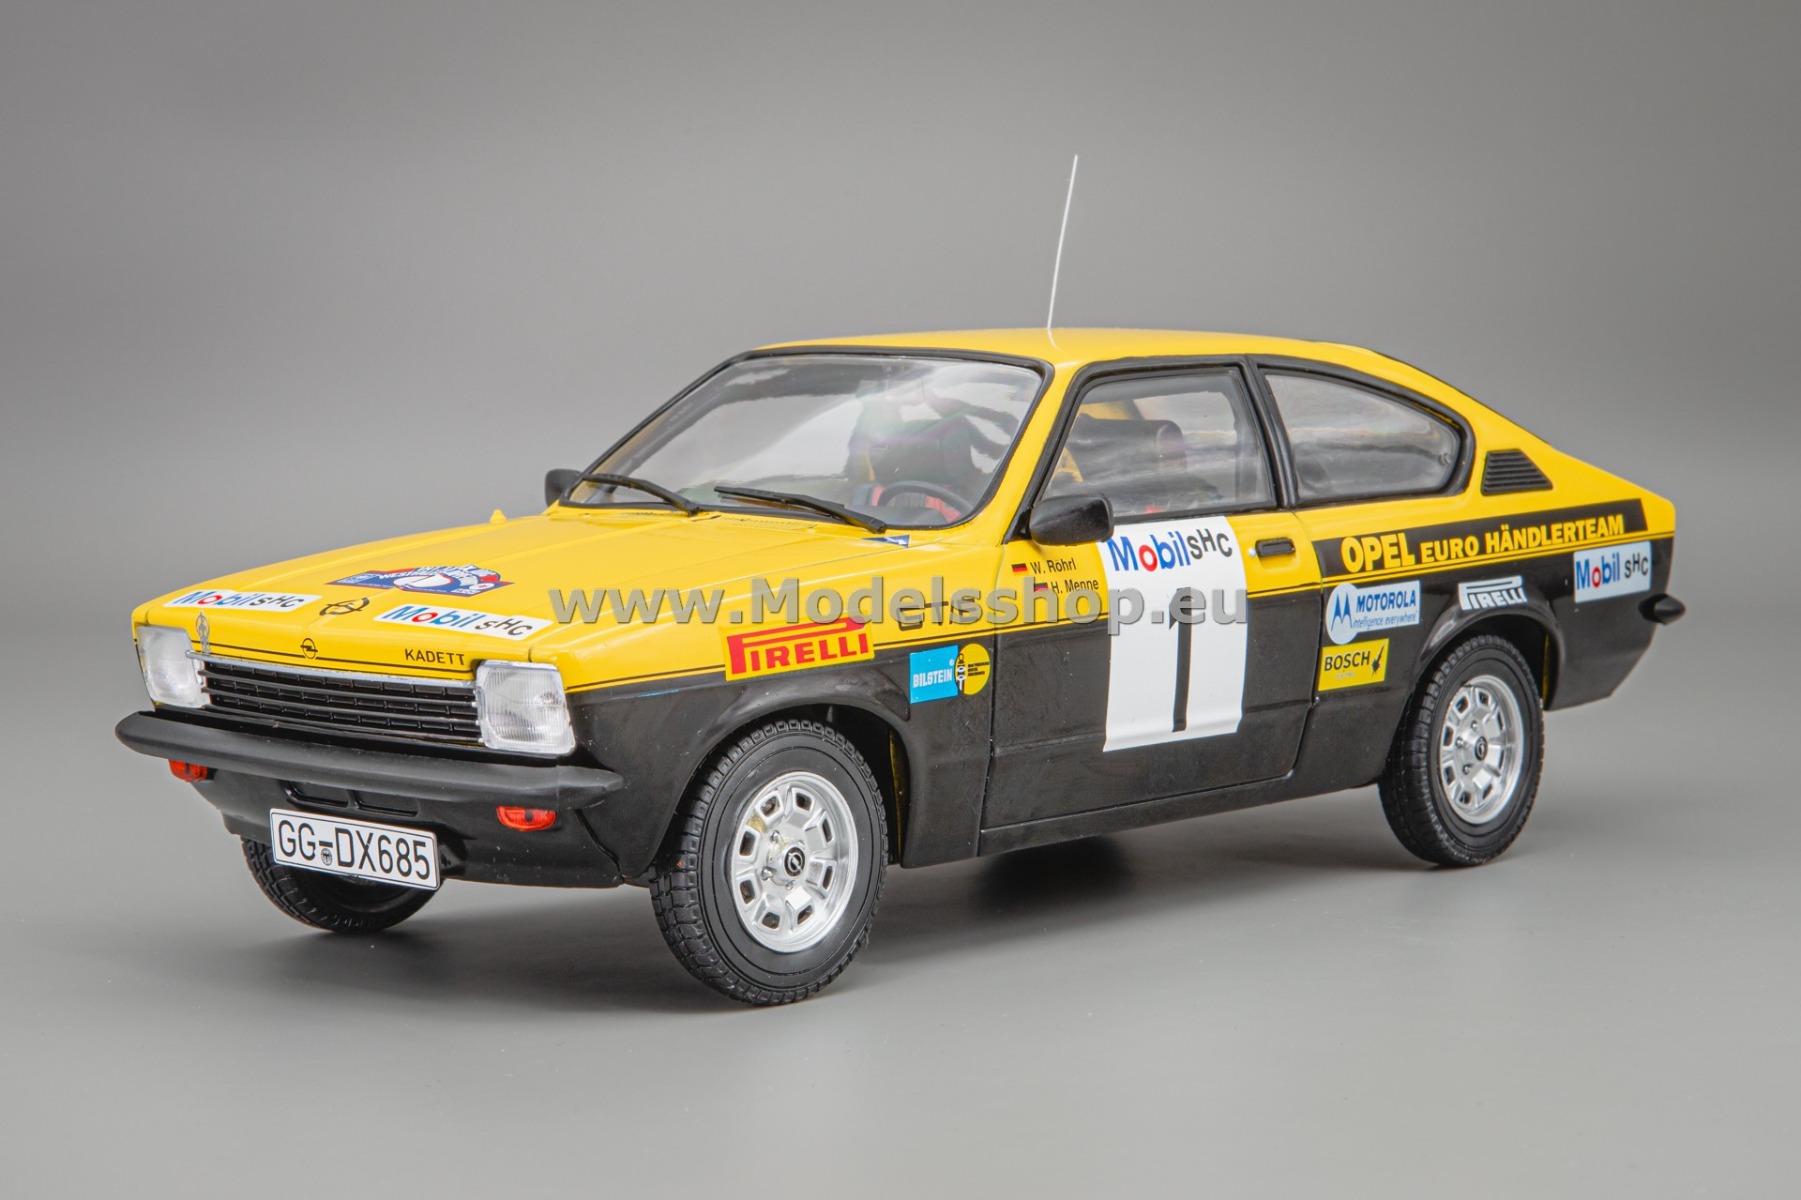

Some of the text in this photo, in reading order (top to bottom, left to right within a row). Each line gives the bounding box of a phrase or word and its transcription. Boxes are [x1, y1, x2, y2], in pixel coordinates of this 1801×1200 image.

[1106, 530, 1191, 572] Mobil
[1341, 513, 1625, 573] OPEL EURO HÄNDLERTEAM
[1030, 561, 1046, 574] W.
[1575, 553, 1620, 591] Mobil
[172, 590, 266, 606] Mobil
[1050, 579, 1099, 594] H. Menne
[1459, 576, 1527, 610] PIRELLI
[1356, 590, 1417, 613] MOTOROLA
[382, 605, 486, 628] Mobil
[405, 648, 464, 666] KADETT
[726, 616, 870, 675] PIRELLI
[1169, 586, 1192, 733] 1
[1324, 650, 1371, 672] BOSCH
[912, 668, 953, 688] BILSTEIN
[278, 819, 431, 880] GG-DX685
